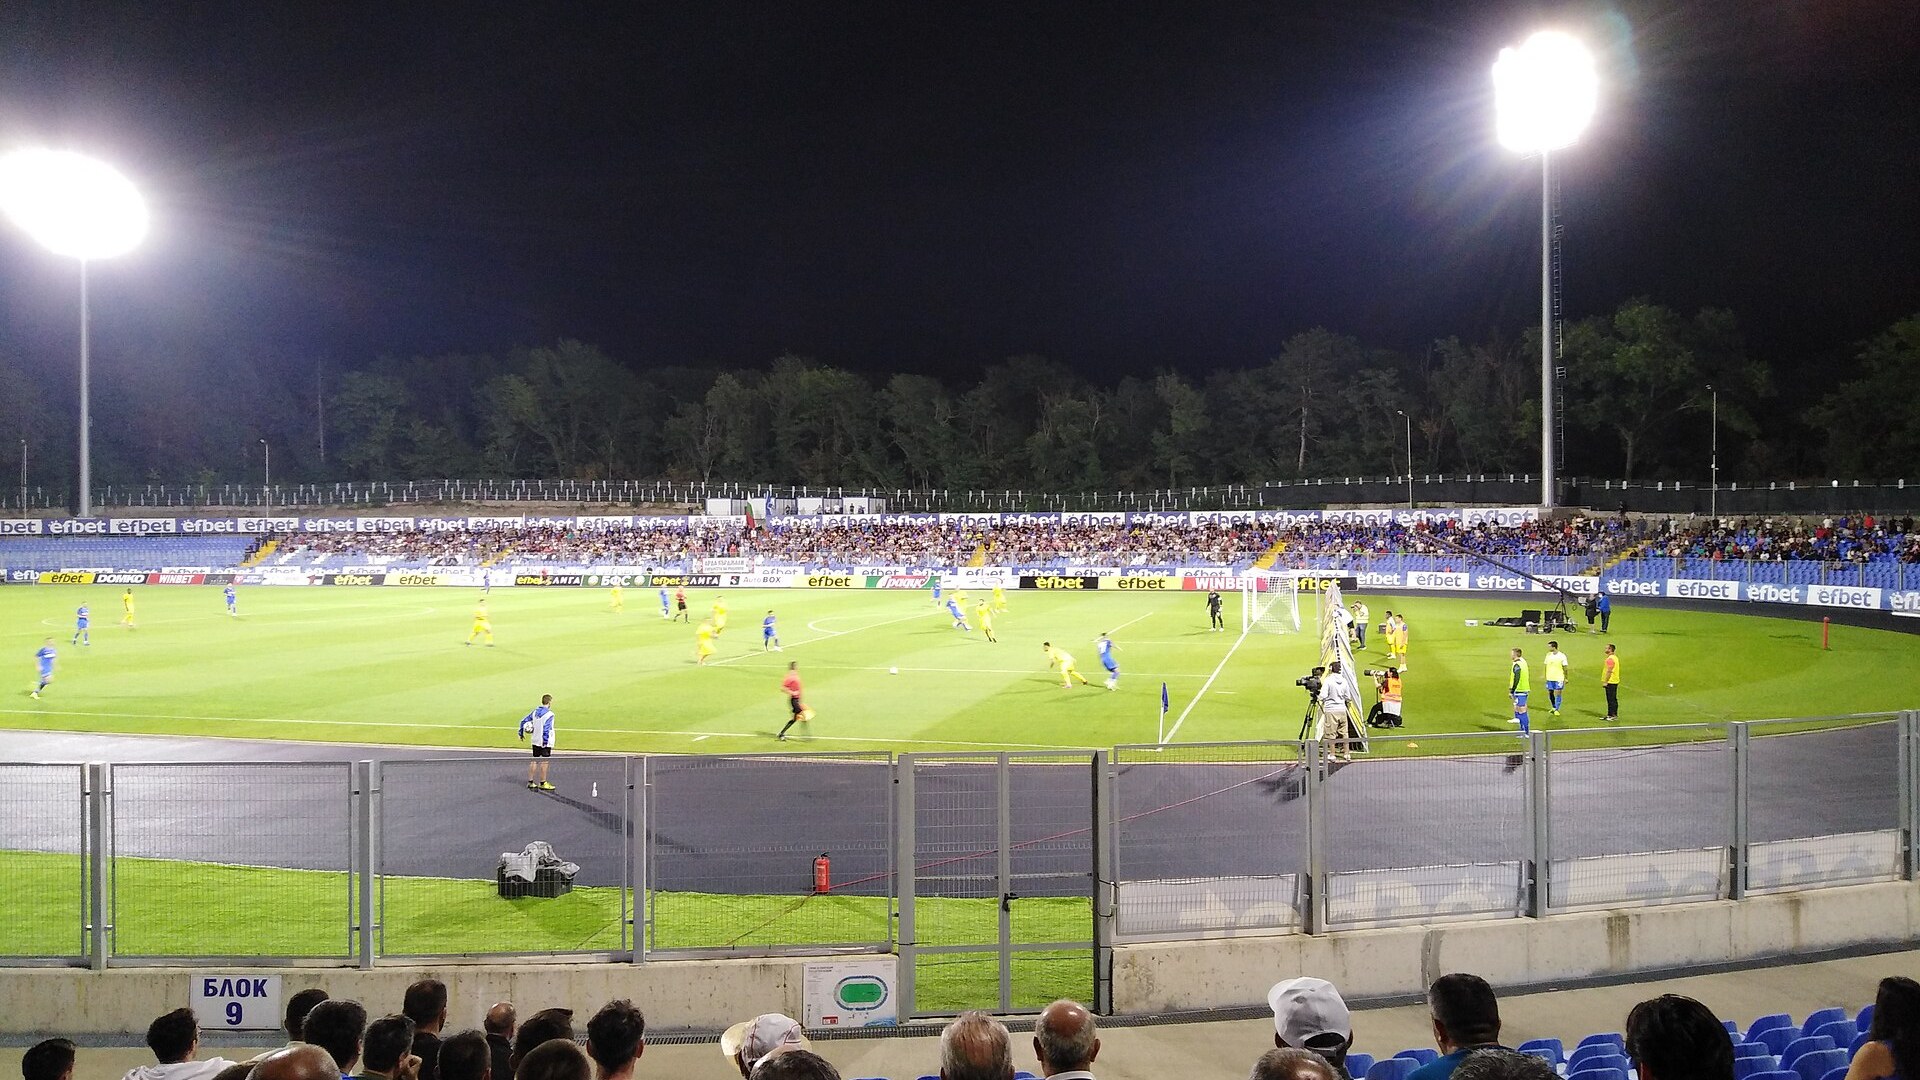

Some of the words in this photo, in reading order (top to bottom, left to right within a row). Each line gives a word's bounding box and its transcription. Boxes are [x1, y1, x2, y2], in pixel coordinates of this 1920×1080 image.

[1470, 510, 1533, 526] efbet
[50, 520, 106, 533] efbet
[118, 519, 170, 533] efbet
[182, 519, 234, 532] efbet
[244, 519, 294, 532] efbet
[305, 519, 354, 531] efbet
[364, 519, 409, 531] efbet
[419, 519, 465, 531] efbet
[14, 570, 40, 580] efb
[51, 573, 84, 583] efbet
[97, 575, 144, 583] DOMKO
[159, 575, 195, 584] WINBET
[334, 575, 373, 585] efbet
[399, 575, 437, 585] efbet
[601, 576, 631, 586] БФС
[690, 577, 719, 585] ЛИГА
[1358, 572, 1400, 586] efbet
[1417, 574, 1461, 587] efbet
[808, 576, 851, 587] efbet
[1036, 576, 1084, 588] efbet
[1117, 577, 1165, 589] efbet
[1477, 575, 1525, 589] efbet
[1608, 579, 1660, 594] efbet
[1678, 582, 1730, 598] efbet
[1747, 585, 1799, 602] efbet
[1818, 588, 1872, 607] efbet
[204, 978, 268, 997] БЛОК
[225, 1002, 243, 1025] 9
